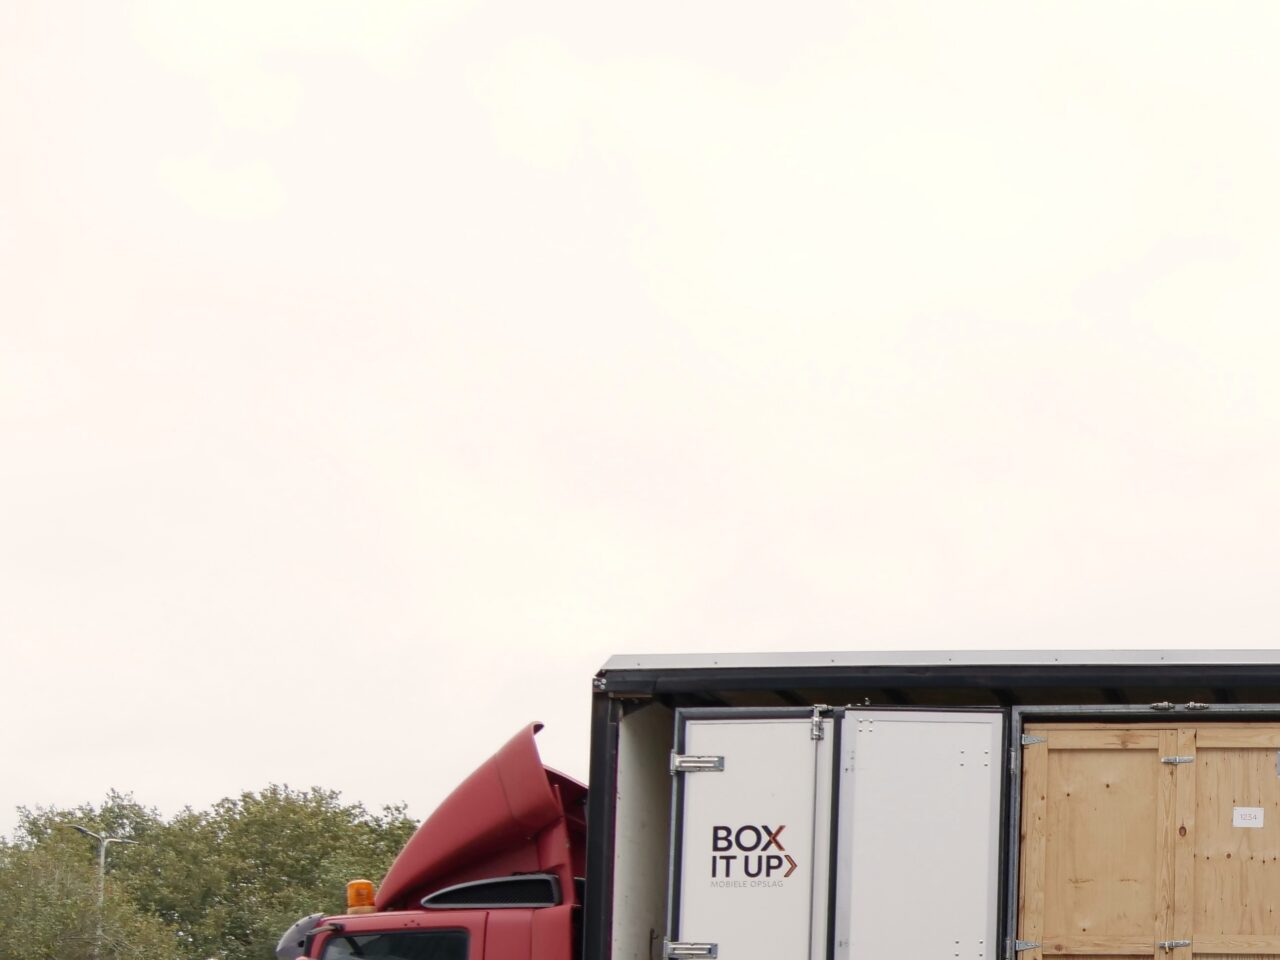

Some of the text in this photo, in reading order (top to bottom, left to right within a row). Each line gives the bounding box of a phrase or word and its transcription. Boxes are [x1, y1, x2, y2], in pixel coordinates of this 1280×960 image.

[712, 825, 786, 852] BOX
[712, 855, 783, 878] IT UP
[710, 880, 784, 888] MOBIELE OPSLAG
